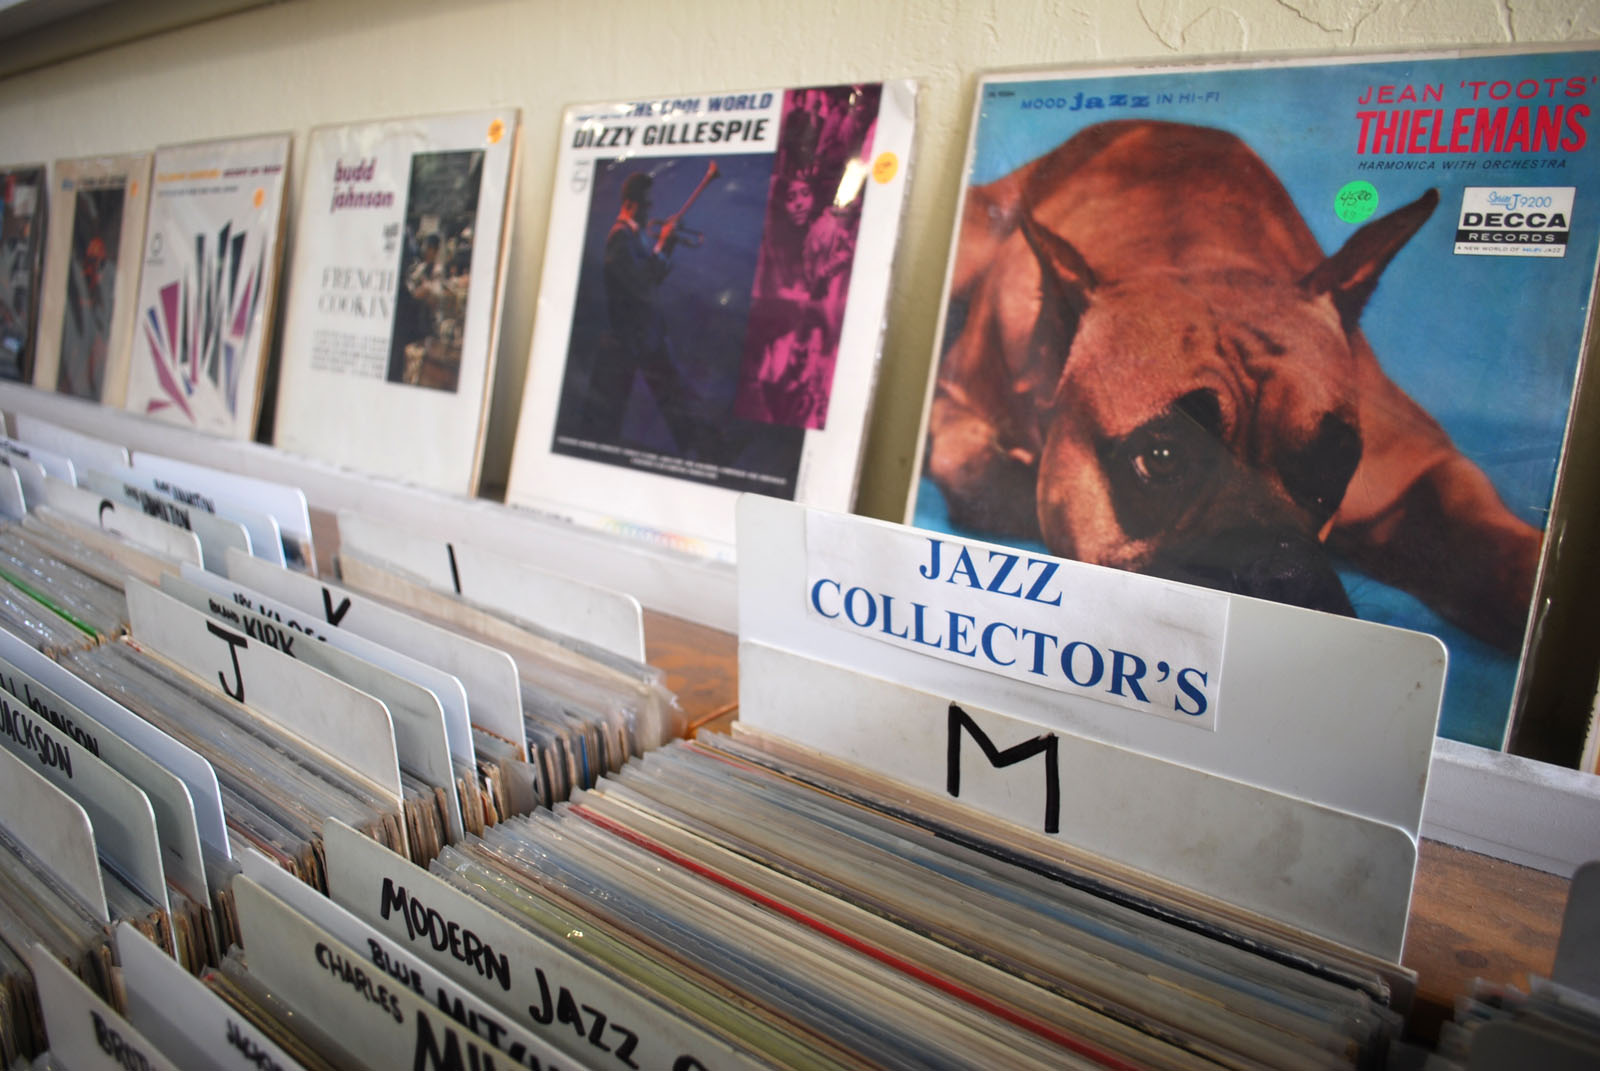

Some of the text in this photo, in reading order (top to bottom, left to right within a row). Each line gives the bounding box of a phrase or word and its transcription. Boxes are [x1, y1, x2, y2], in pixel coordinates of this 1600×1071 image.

[707, 93, 774, 111] WORLD
[1020, 91, 1221, 111] MOOD jazz IN HI-FI
[1358, 76, 1598, 105] JEAN 'TOOTS'
[572, 118, 770, 149] DIZZY GILLESPIE
[1356, 103, 1592, 155] THIELEMANS
[333, 157, 378, 183] budd
[1357, 158, 1567, 171] HARMONICA WITH ORCHESTRA
[1462, 212, 1568, 229] DECCA
[1468, 232, 1556, 243] RECORDS
[918, 537, 1063, 608] JAZZ
[206, 620, 249, 704] J
[810, 577, 1209, 717] COLLECTOR'S
[947, 701, 1060, 833] M
[315, 942, 404, 1024] CHARLES
[380, 877, 511, 992] MODERN
[529, 967, 639, 1070] JAZZ
